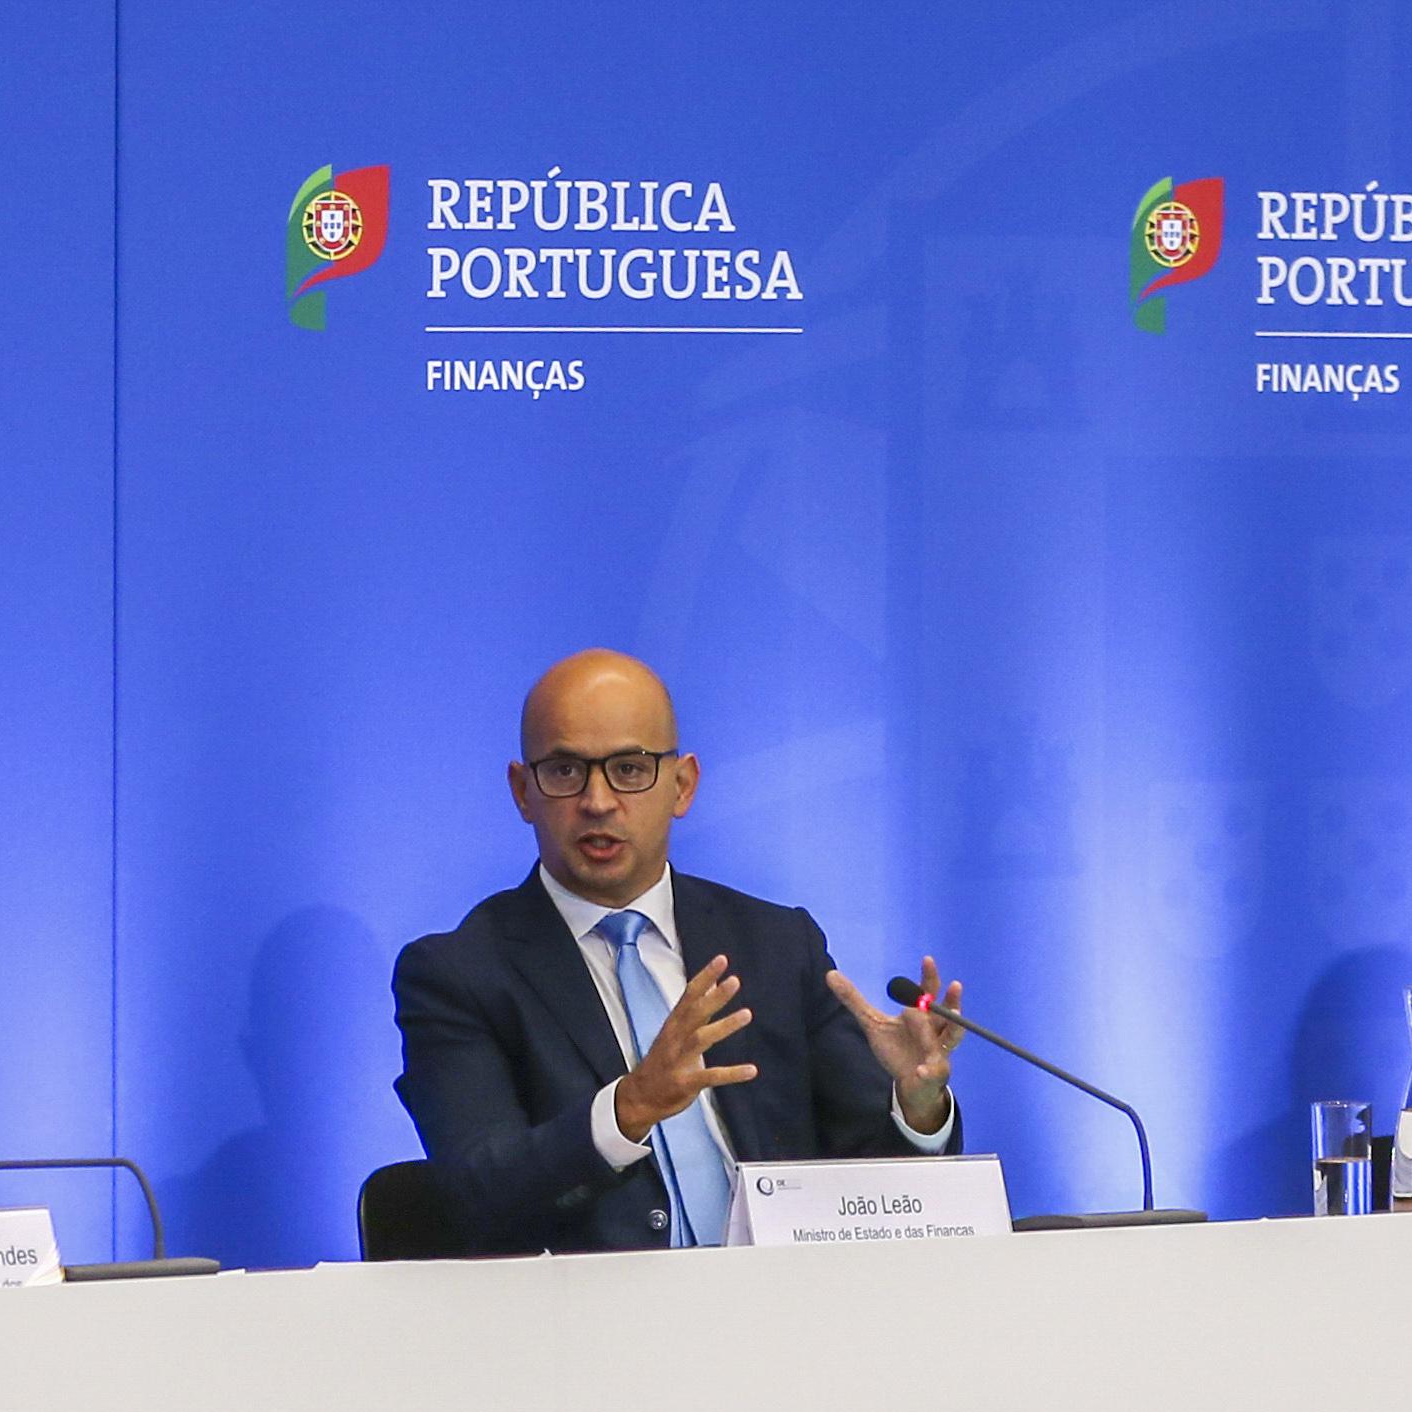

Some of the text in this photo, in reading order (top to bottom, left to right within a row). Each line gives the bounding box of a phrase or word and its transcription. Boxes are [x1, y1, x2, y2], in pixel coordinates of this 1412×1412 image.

[428, 166, 736, 232] REPÚBLICA
[427, 247, 803, 299] PORTUGUESA
[427, 360, 585, 399] FINANÇAS
[1256, 363, 1400, 401] FINANÇAS
[838, 1194, 922, 1216] João Leão
[793, 1228, 836, 1242] Ministro
[838, 1228, 852, 1241] de
[854, 1226, 892, 1240] Estado
[894, 1229, 902, 1239] e
[904, 1225, 924, 1239] das
